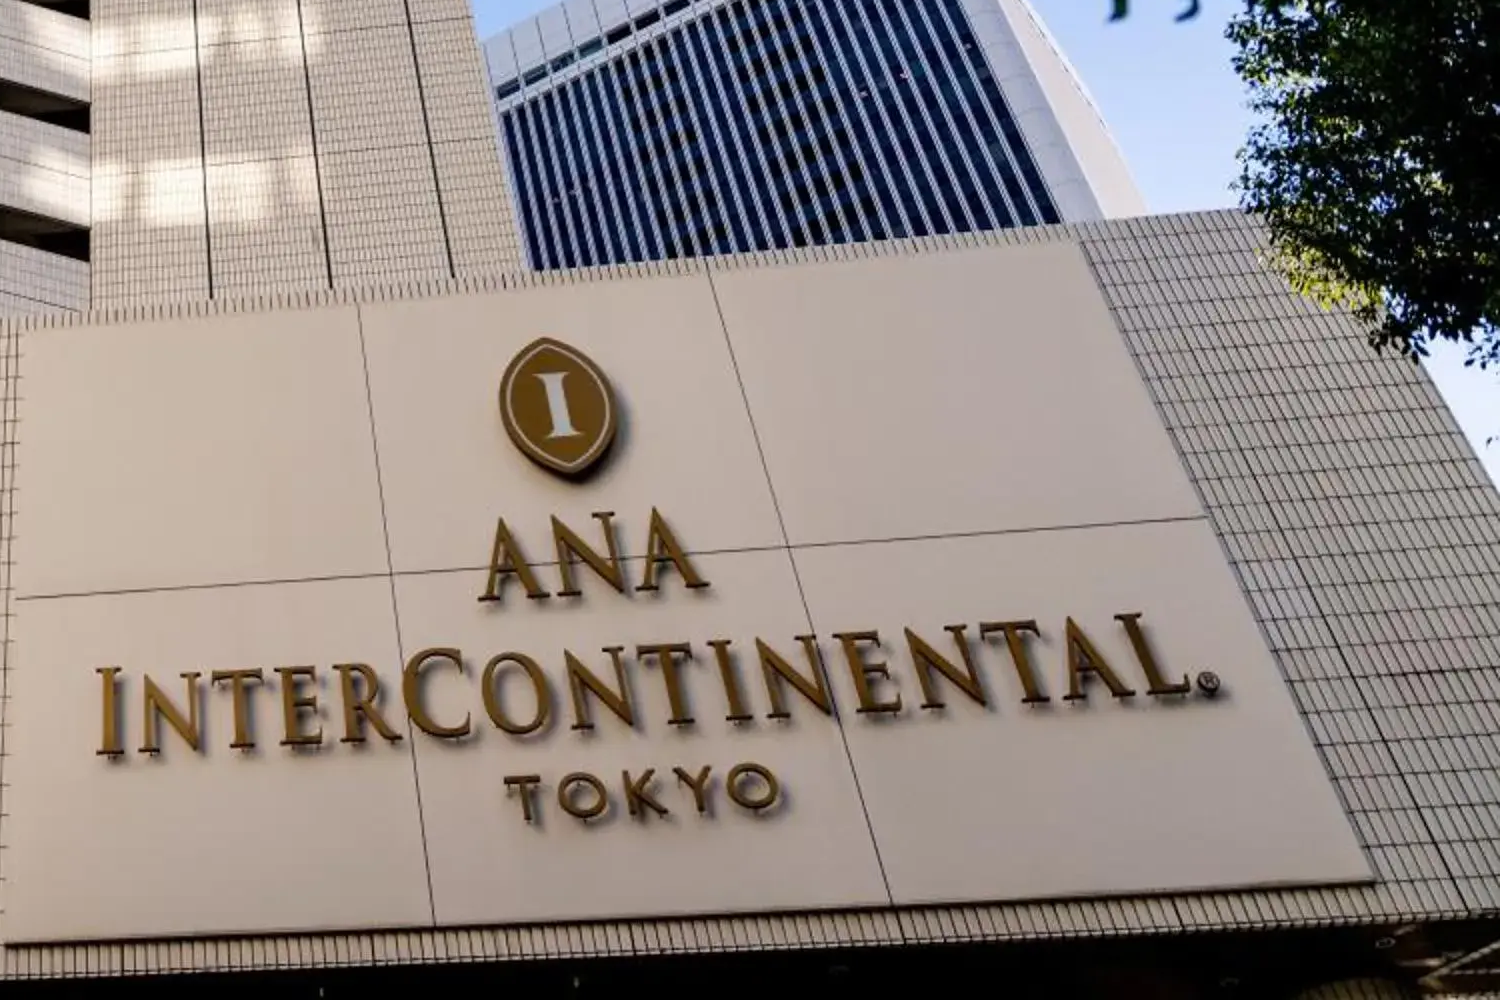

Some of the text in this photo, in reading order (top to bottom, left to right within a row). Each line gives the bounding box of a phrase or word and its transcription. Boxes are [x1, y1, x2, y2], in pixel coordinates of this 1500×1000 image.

[532, 371, 585, 439] I
[478, 505, 711, 602] ANA
[503, 762, 779, 821] TOKYO
